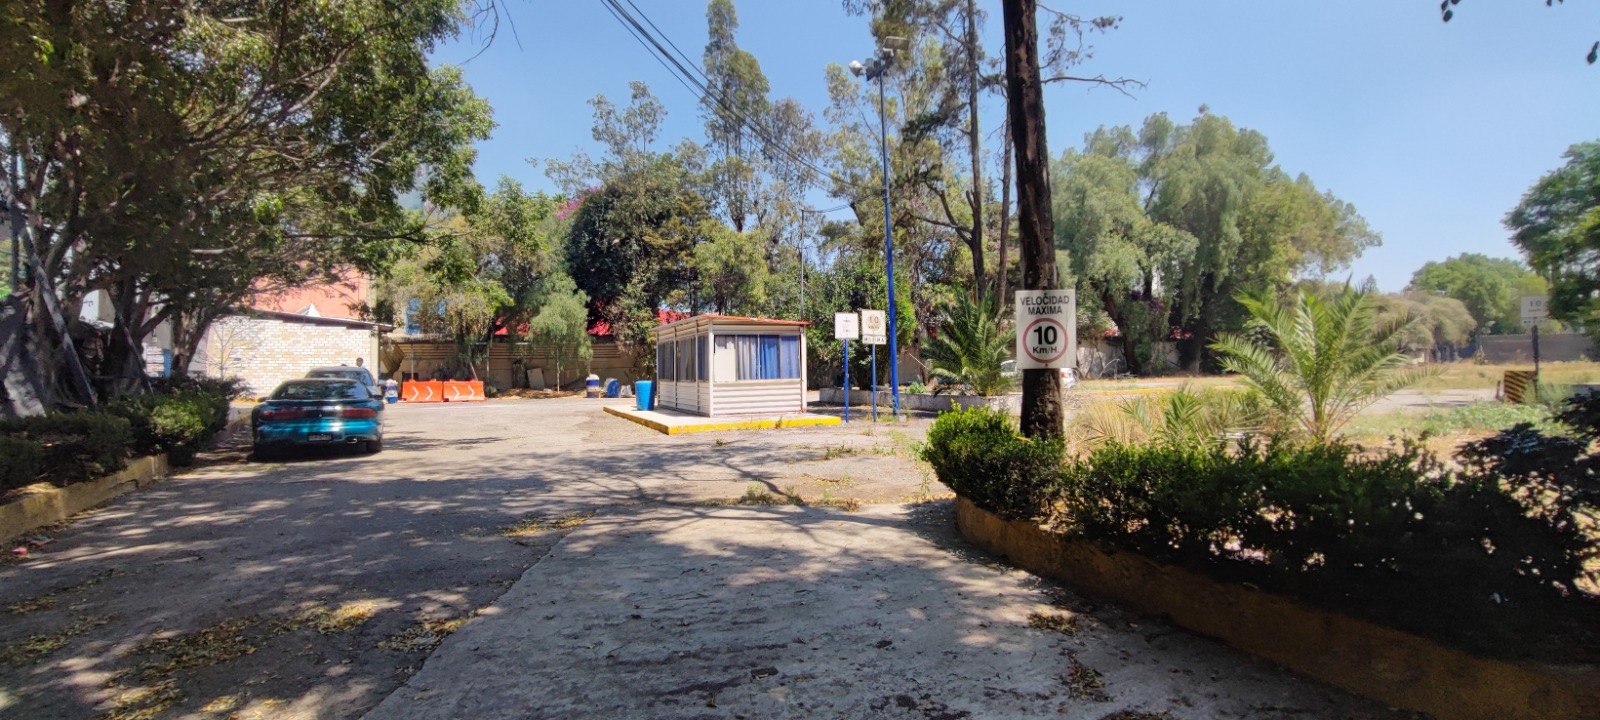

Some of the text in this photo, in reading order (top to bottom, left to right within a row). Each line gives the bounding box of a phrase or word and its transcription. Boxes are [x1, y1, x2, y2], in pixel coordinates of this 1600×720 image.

[1020, 295, 1070, 306] VELOCIDAD
[1027, 306, 1063, 315] MAXIMA
[1033, 326, 1058, 345] 10
